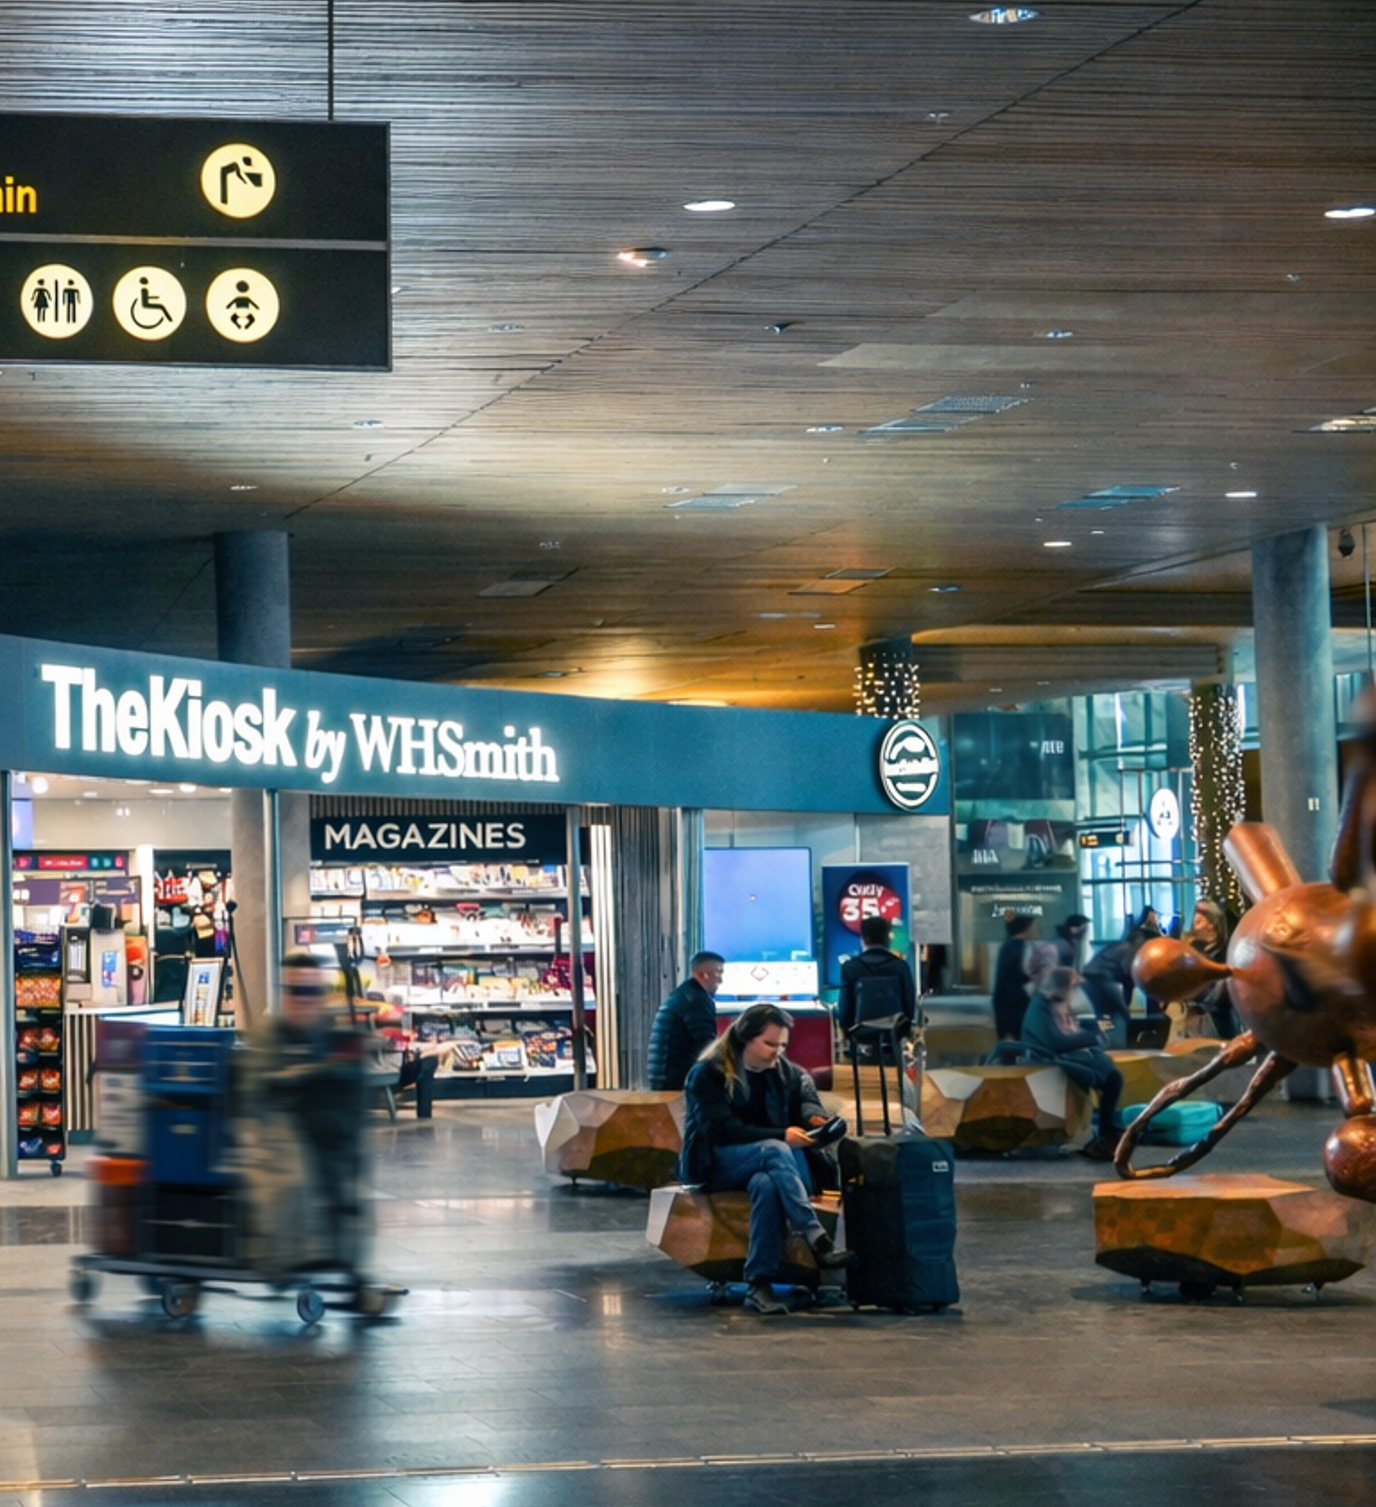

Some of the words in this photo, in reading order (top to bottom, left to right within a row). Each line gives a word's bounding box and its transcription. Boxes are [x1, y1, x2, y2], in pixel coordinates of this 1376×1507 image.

[41, 664, 298, 767] TheKiosk
[304, 709, 347, 783] by
[349, 713, 560, 783] WHSmith
[325, 823, 526, 849] MAGAZINES
